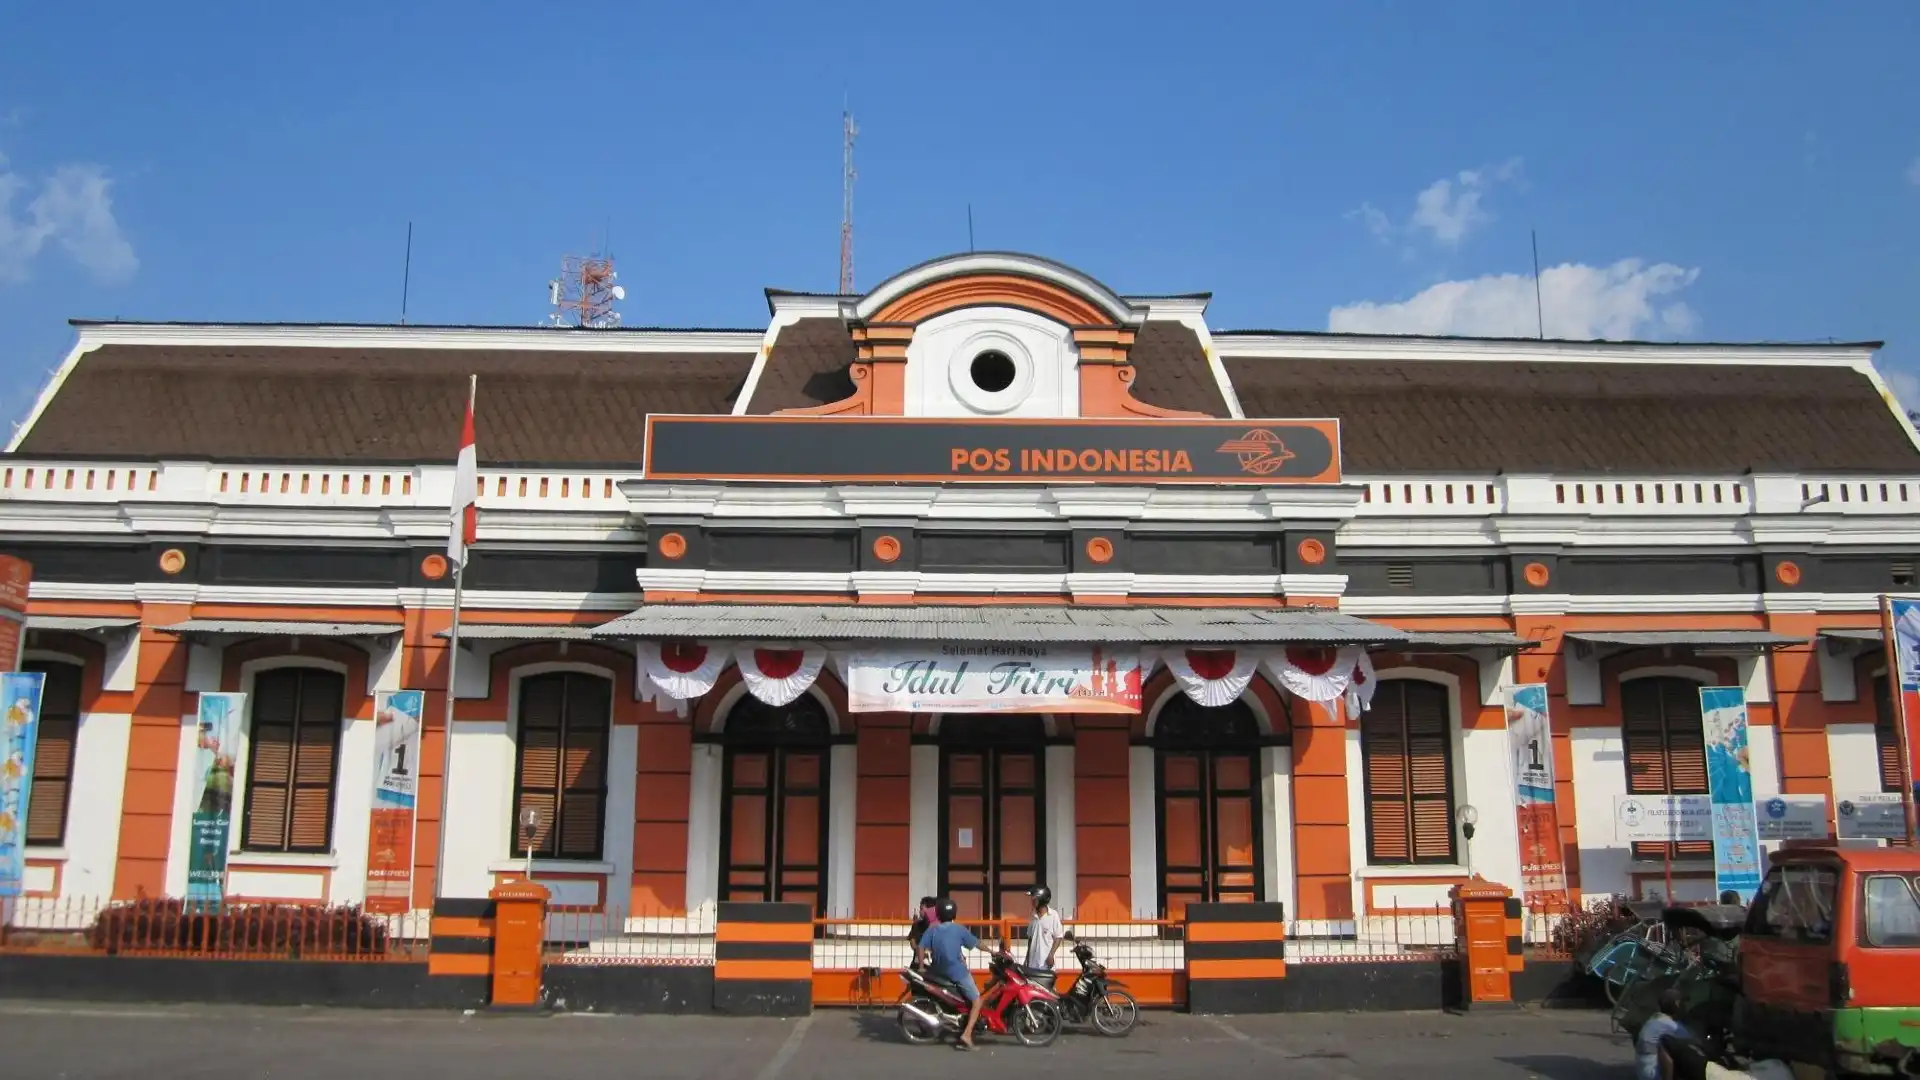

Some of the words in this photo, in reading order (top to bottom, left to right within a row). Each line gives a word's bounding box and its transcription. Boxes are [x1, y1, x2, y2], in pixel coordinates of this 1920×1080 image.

[951, 448, 1010, 472] POS
[1021, 449, 1193, 472] INDONESIA
[942, 645, 987, 656] Selamat
[991, 645, 1015, 656] Hari
[883, 660, 969, 695] Idul
[987, 661, 1079, 695] Fitri
[391, 743, 408, 776] 1
[1528, 739, 1544, 770] 1
